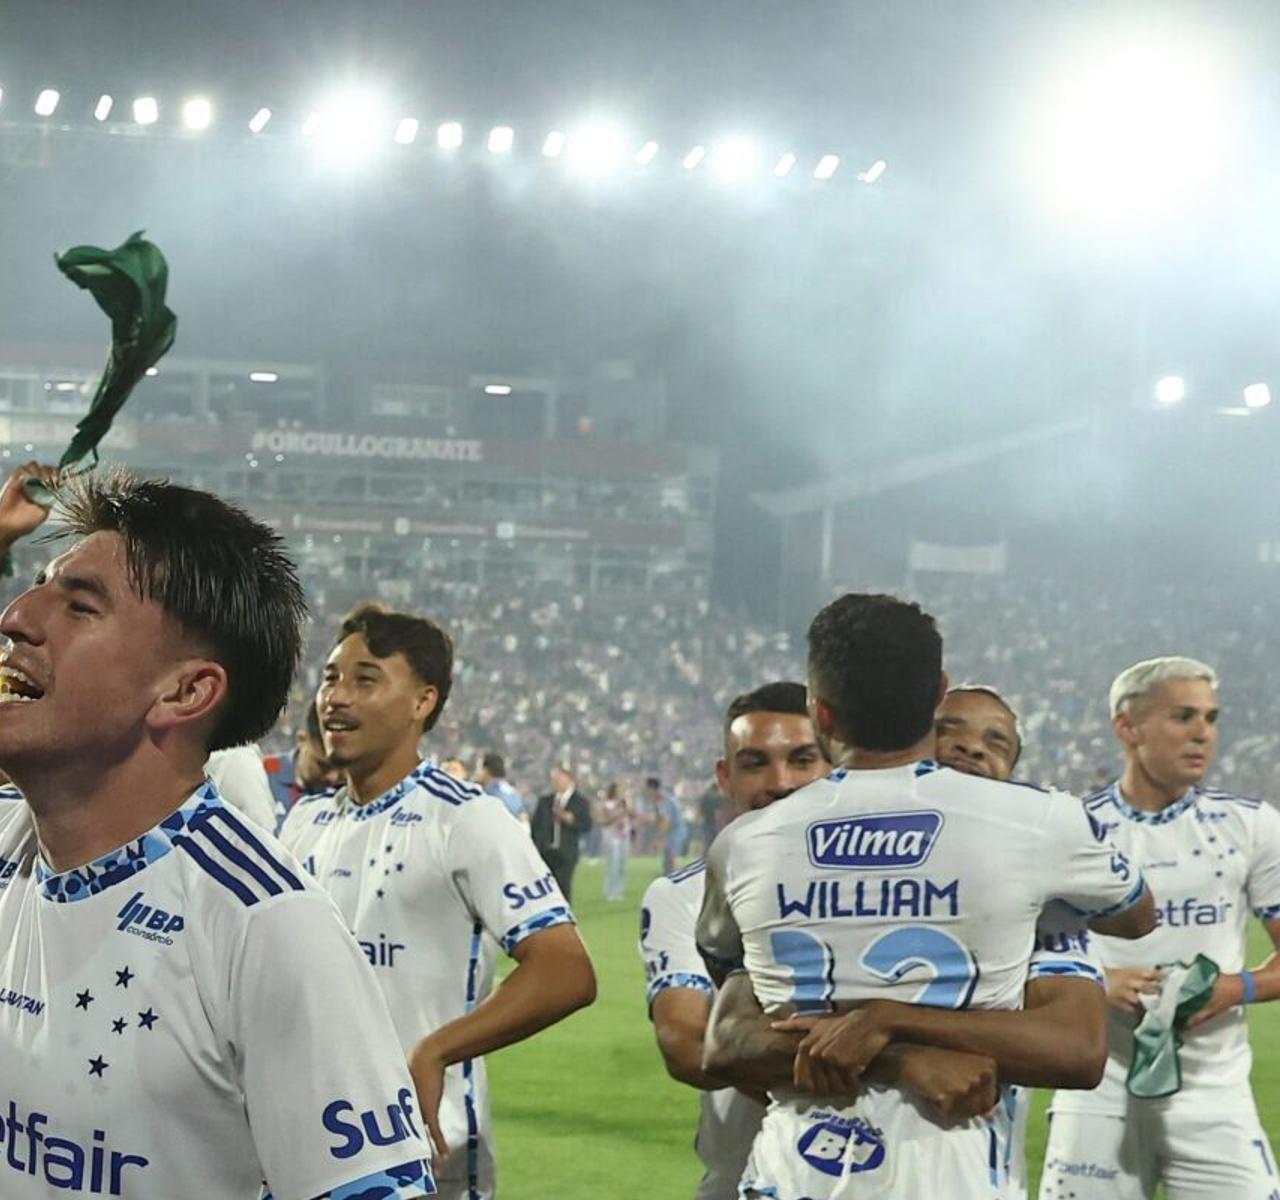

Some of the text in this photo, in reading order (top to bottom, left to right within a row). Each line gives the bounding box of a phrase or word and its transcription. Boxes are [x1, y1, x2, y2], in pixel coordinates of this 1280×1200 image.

[814, 825, 925, 857] Vilma
[503, 871, 554, 910] Sur
[778, 879, 959, 919] WILLIAM
